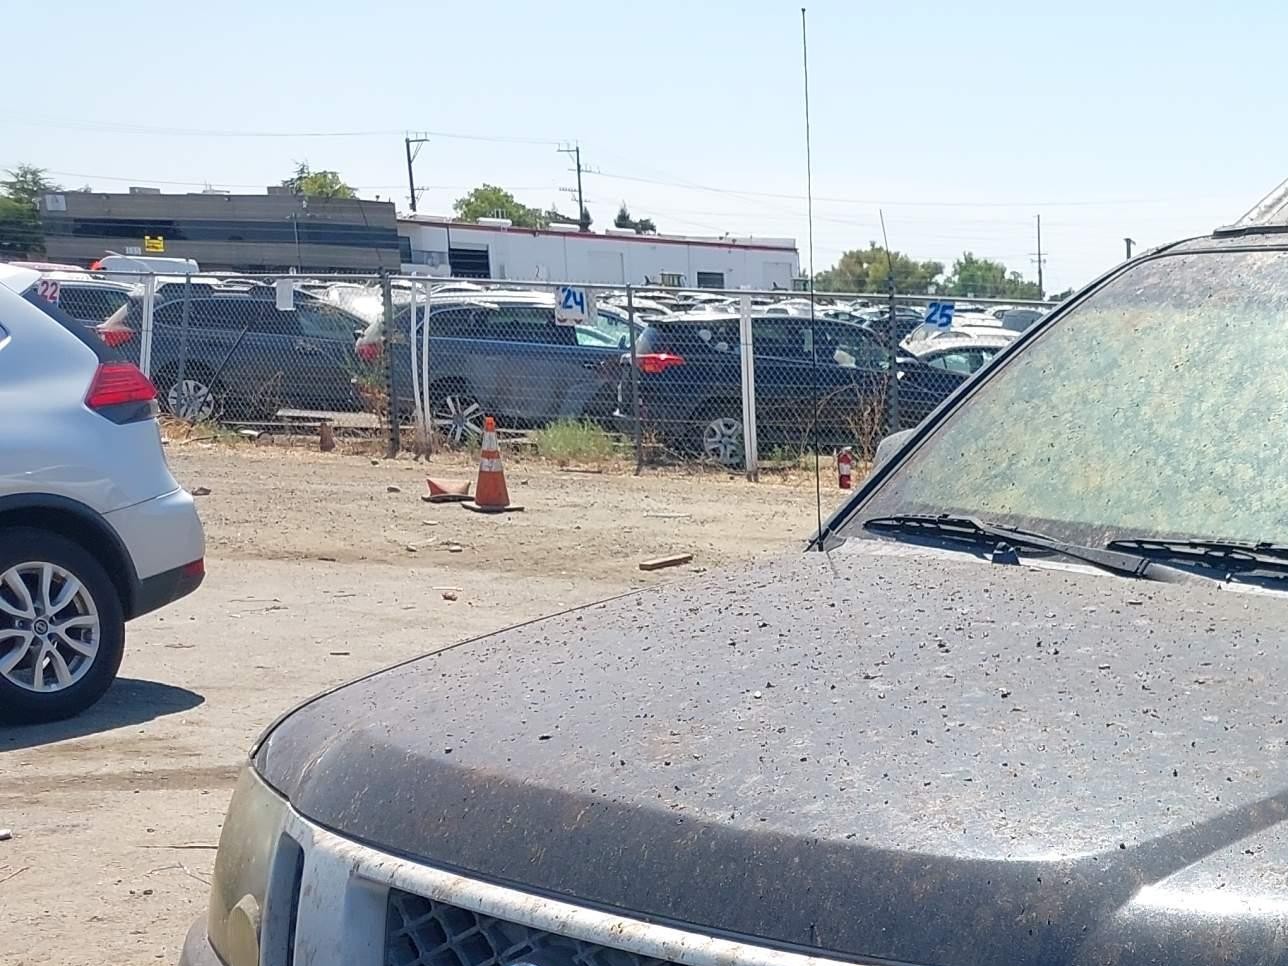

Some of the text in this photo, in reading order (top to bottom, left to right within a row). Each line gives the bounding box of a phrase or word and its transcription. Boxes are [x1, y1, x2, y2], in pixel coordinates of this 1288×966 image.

[41, 280, 58, 300] 22
[562, 287, 585, 315] 24
[925, 302, 955, 327] 25
